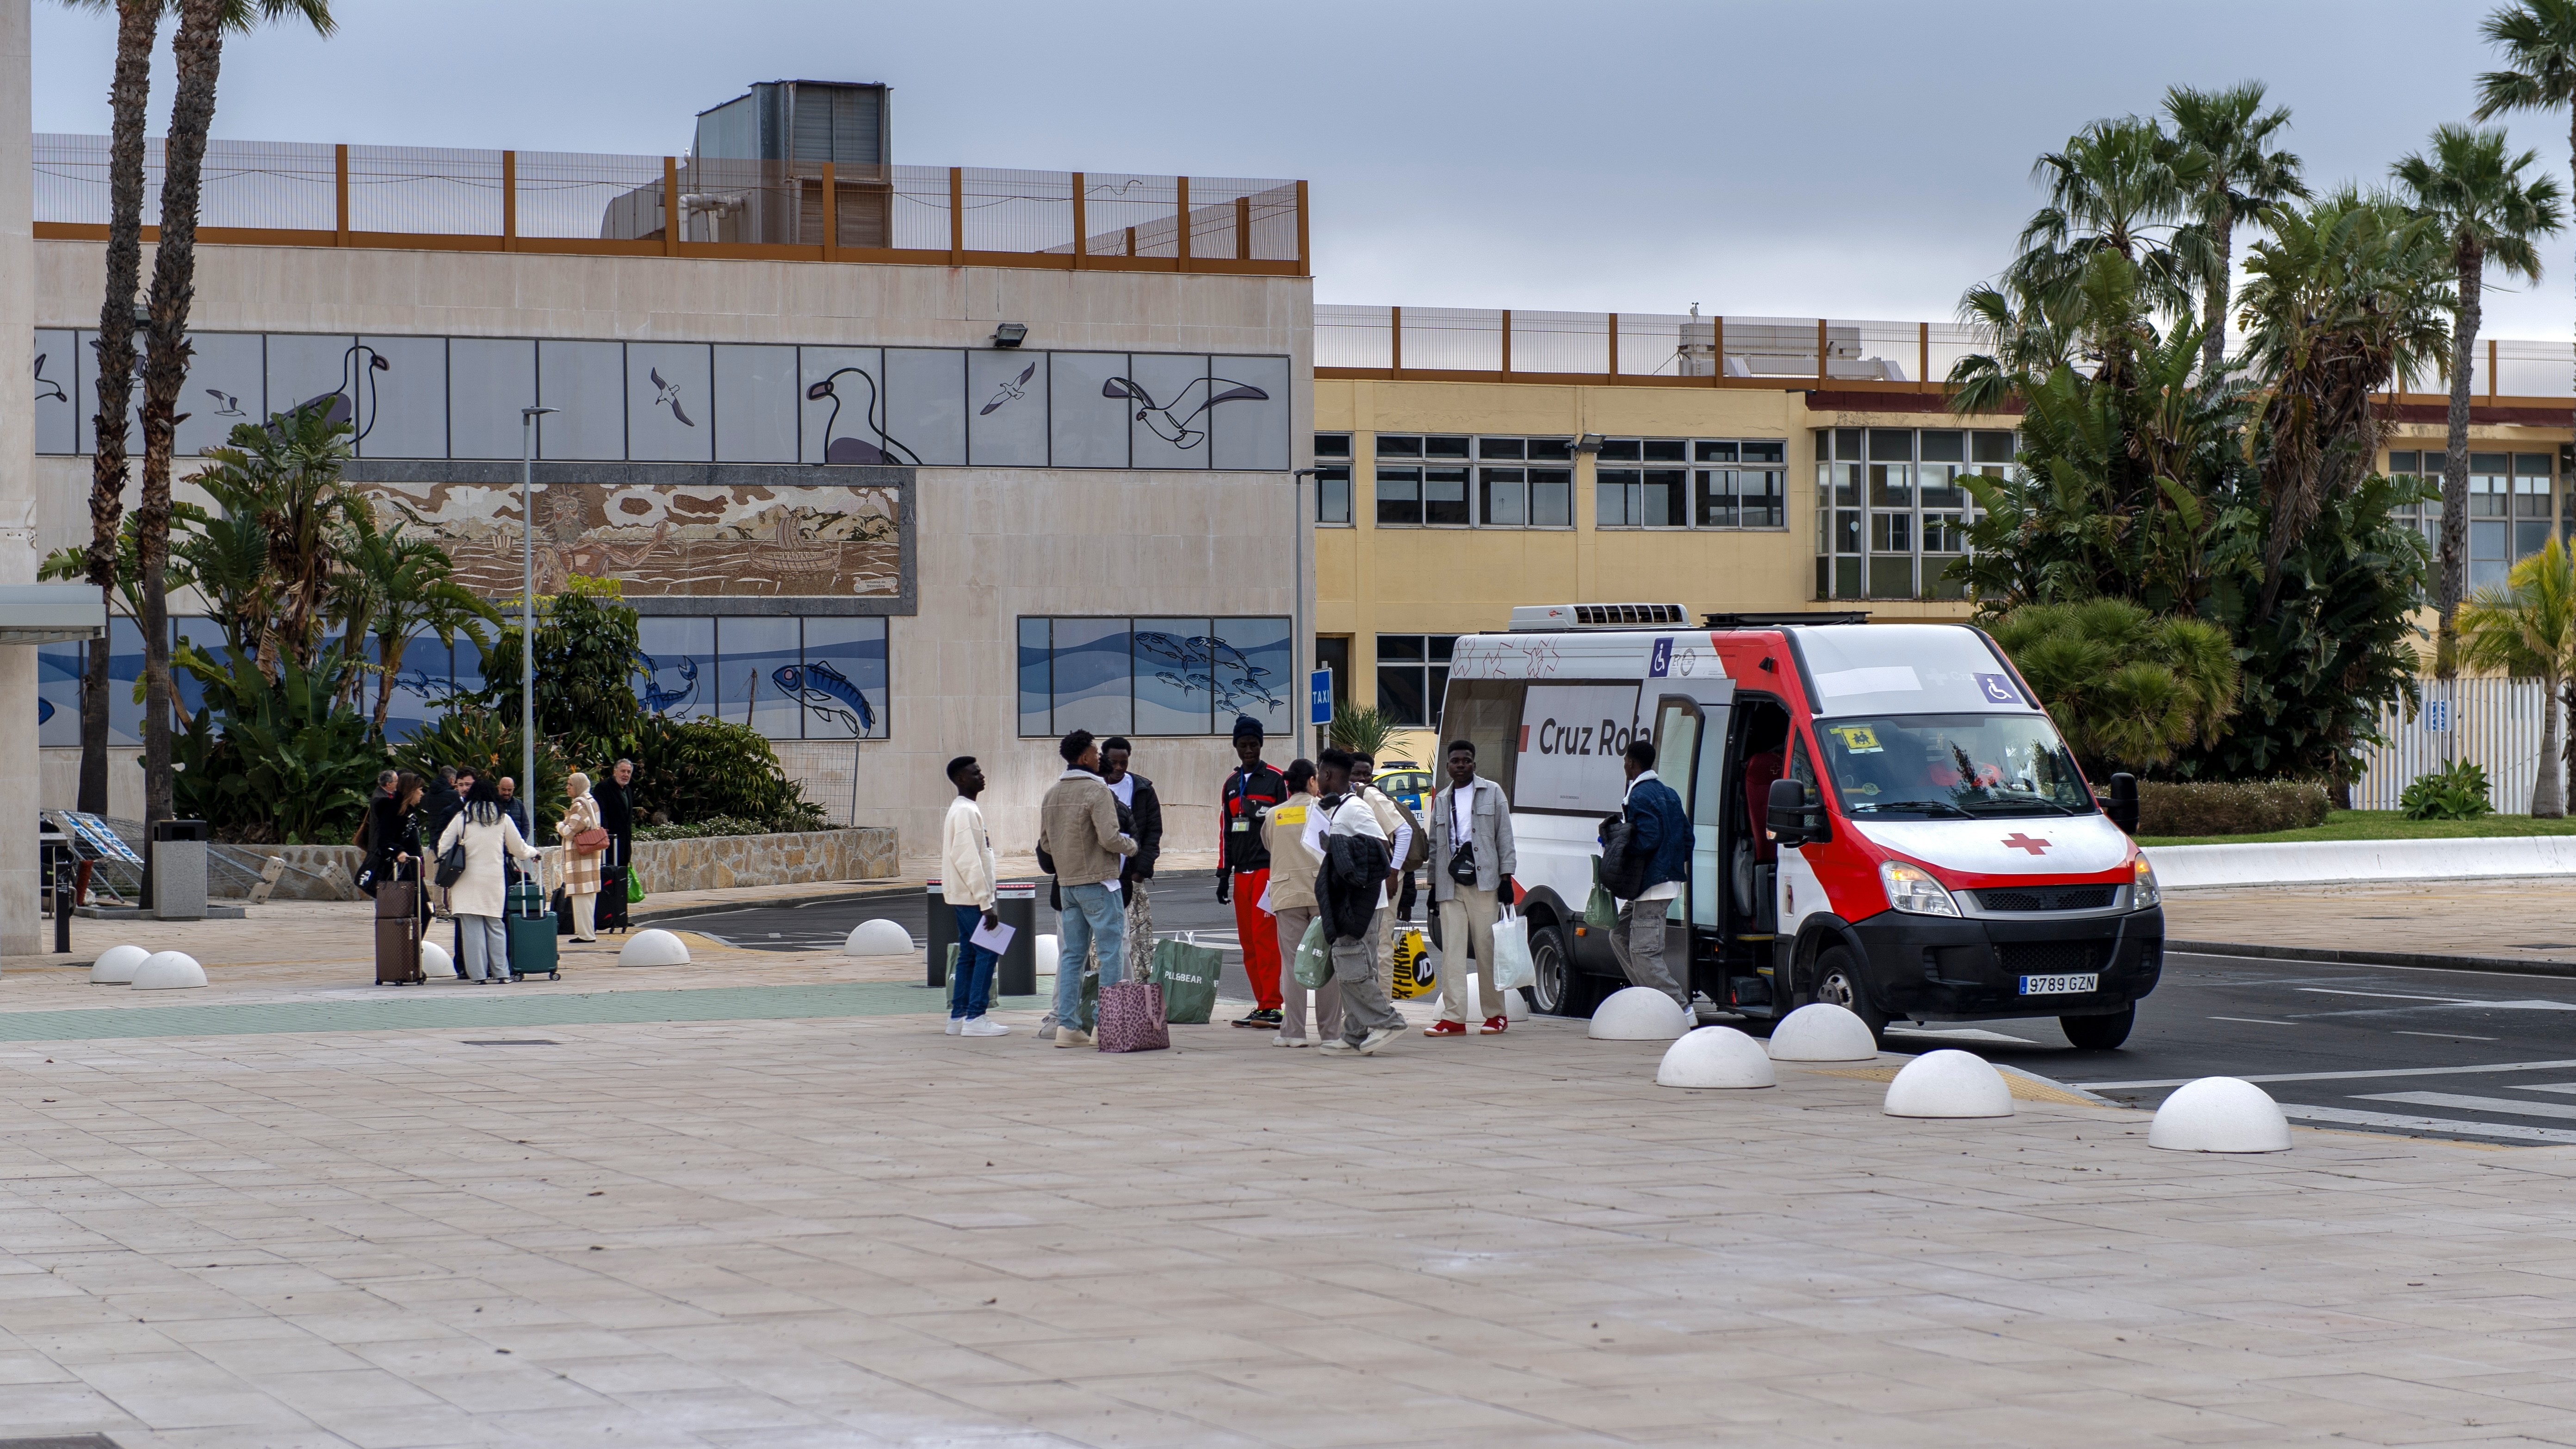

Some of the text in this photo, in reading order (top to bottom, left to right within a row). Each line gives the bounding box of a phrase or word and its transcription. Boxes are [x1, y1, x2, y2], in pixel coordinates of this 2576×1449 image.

[1951, 671, 1976, 681] Cru
[1313, 689, 1330, 705] TAXI
[1539, 718, 1593, 755] Cruz
[1164, 971, 1202, 984] PUL&BEAR
[1417, 958, 1433, 982] JD
[2030, 976, 2095, 992] 9789 GZN
